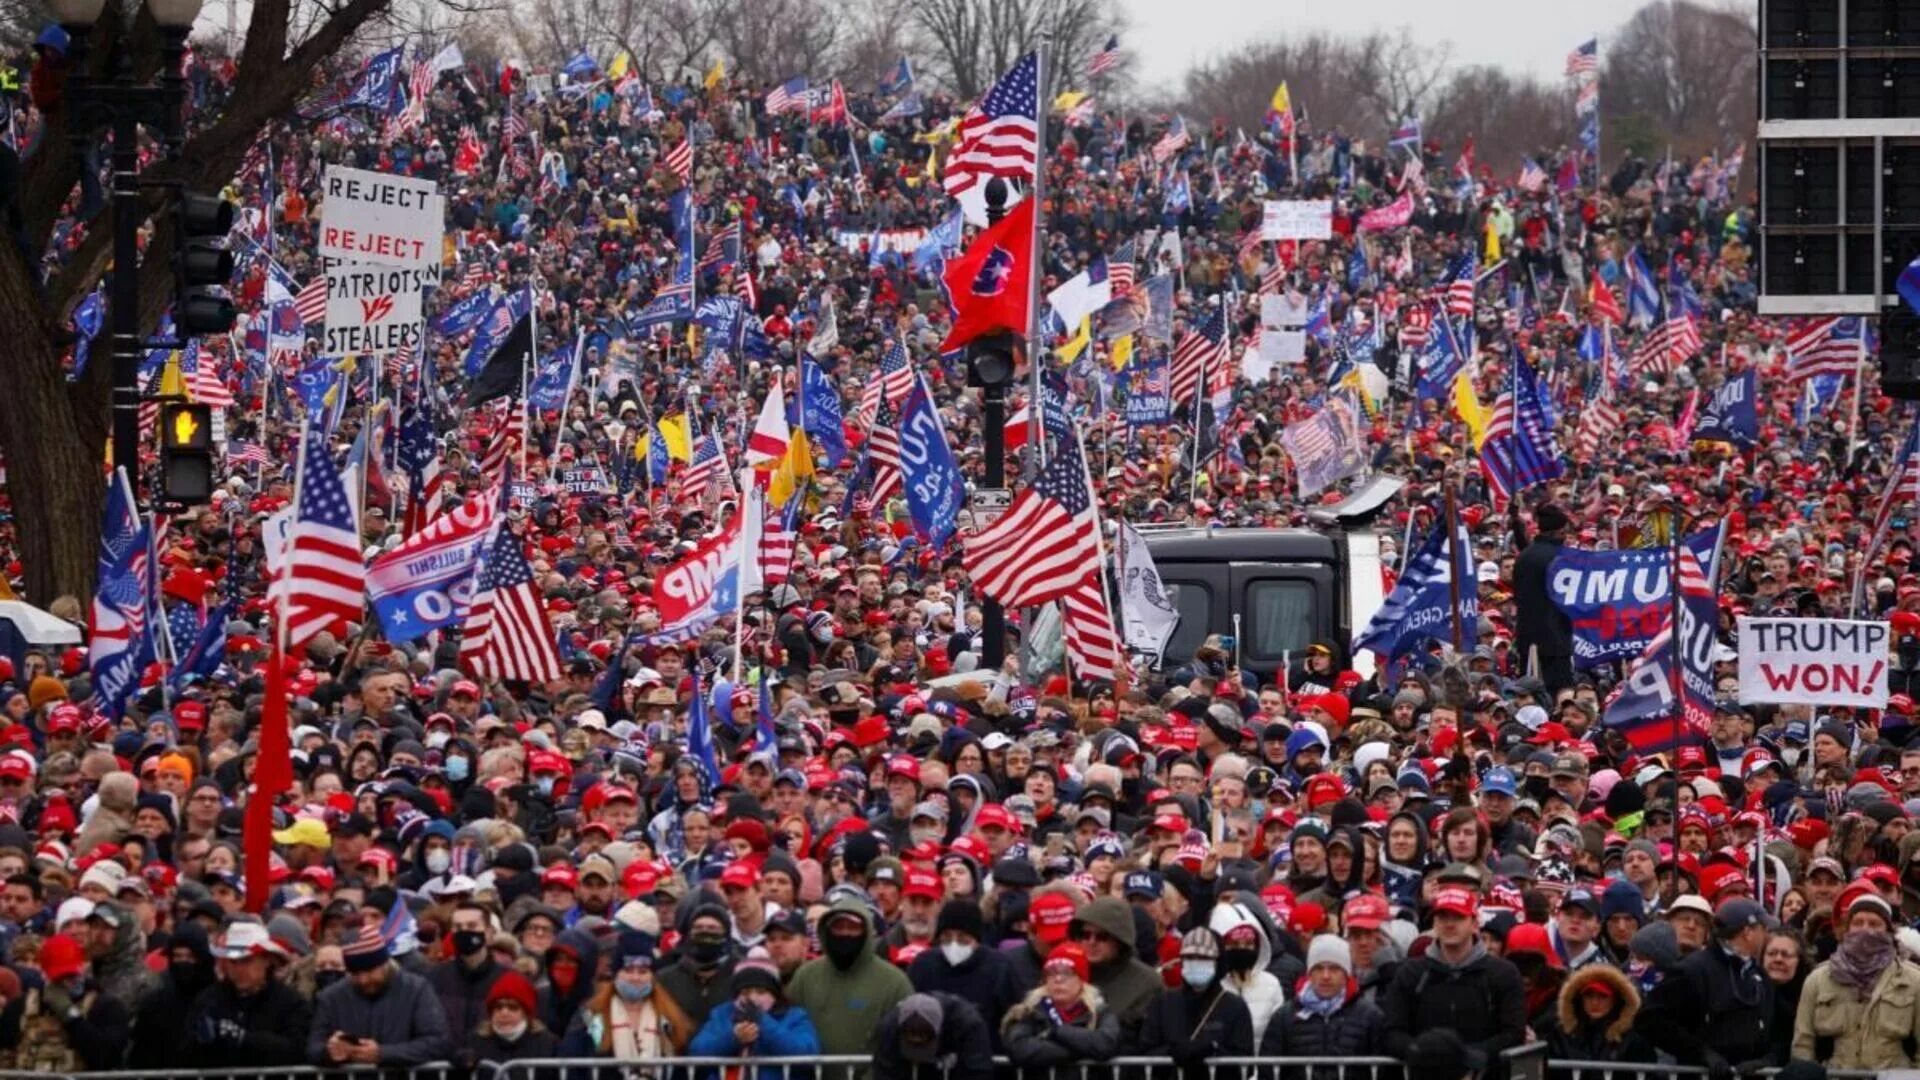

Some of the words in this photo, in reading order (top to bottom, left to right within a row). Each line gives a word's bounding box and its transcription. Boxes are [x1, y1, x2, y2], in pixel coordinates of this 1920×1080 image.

[329, 177, 429, 210] REJECT
[324, 227, 424, 260] REJECT
[327, 269, 422, 299] PATRIOTS
[361, 294, 394, 323] VS
[327, 321, 421, 353] STEALERS
[565, 470, 600, 481] STOP
[1750, 622, 1885, 653] TRUMP
[1759, 660, 1884, 695] WON!
